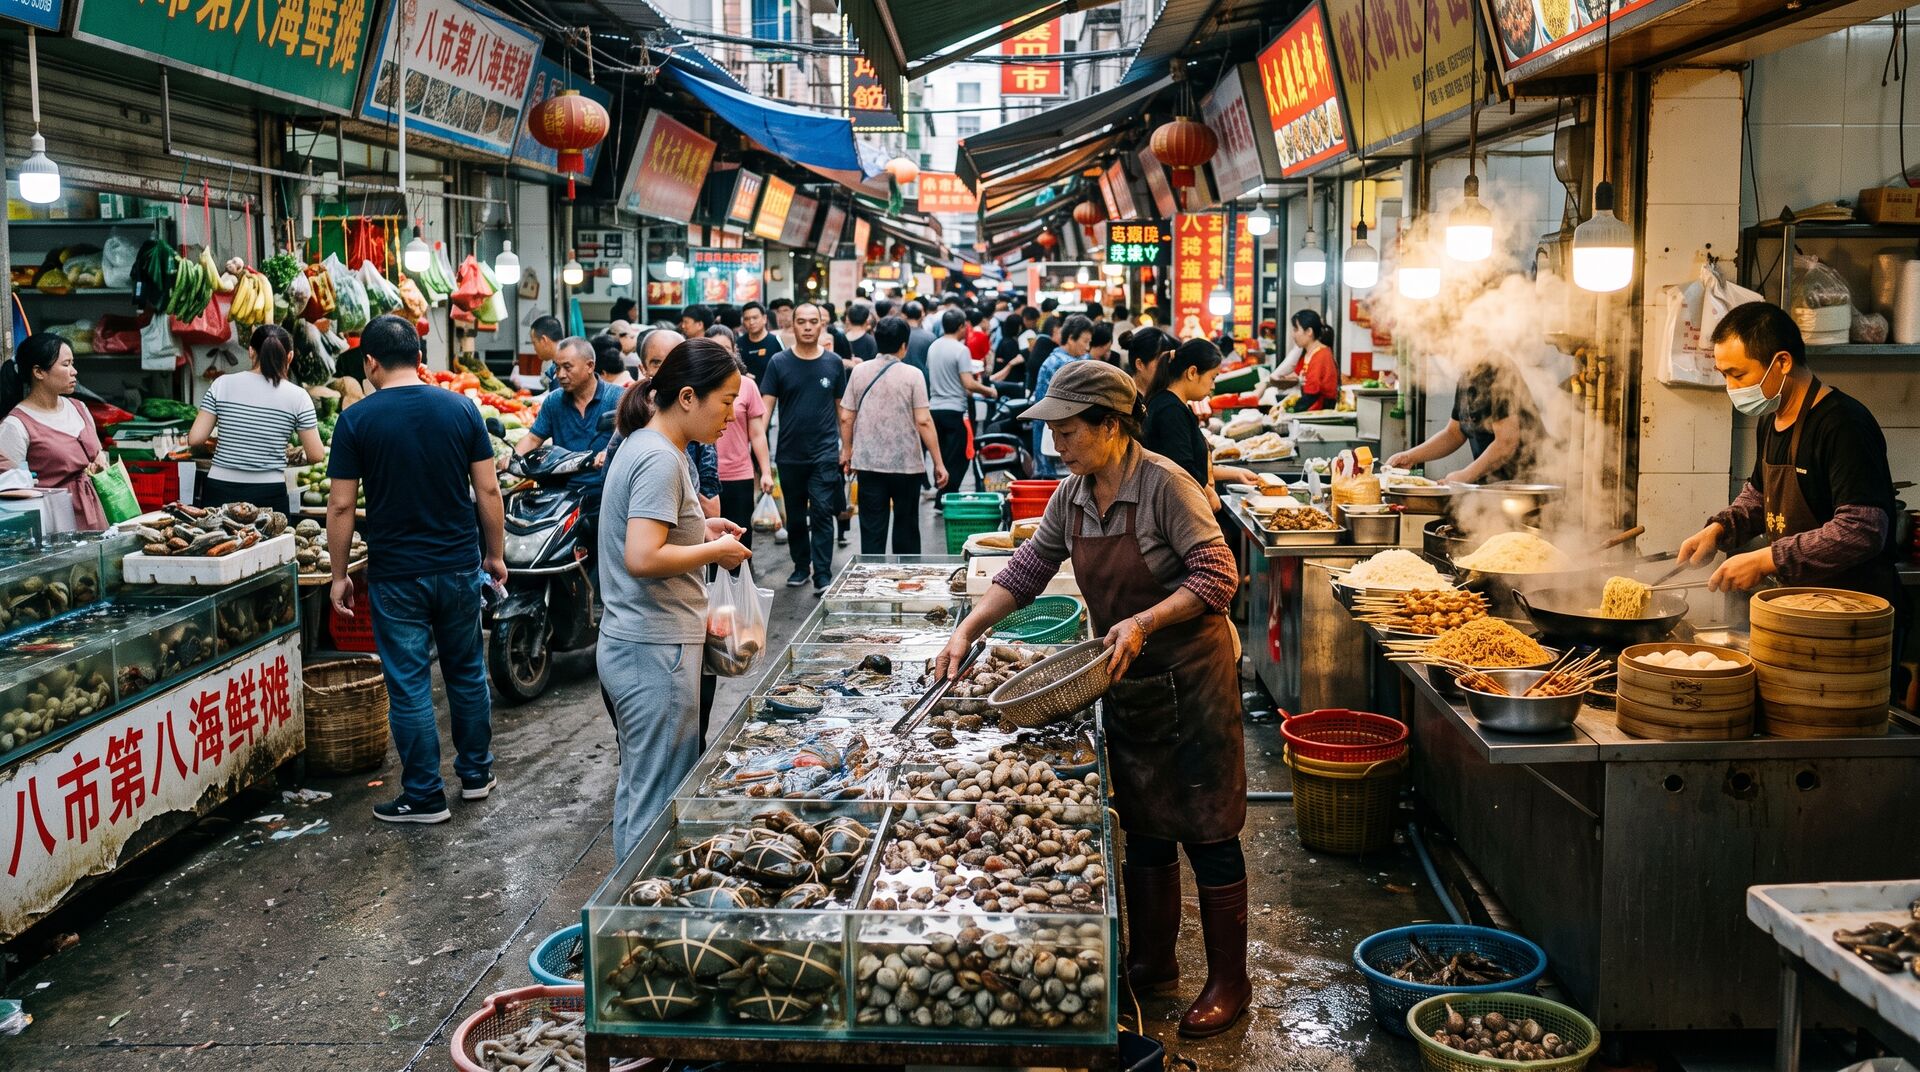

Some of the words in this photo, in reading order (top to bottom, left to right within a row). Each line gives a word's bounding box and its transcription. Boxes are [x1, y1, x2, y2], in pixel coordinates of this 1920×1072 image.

[7, 654, 292, 878] 八市第八海鲜摊
